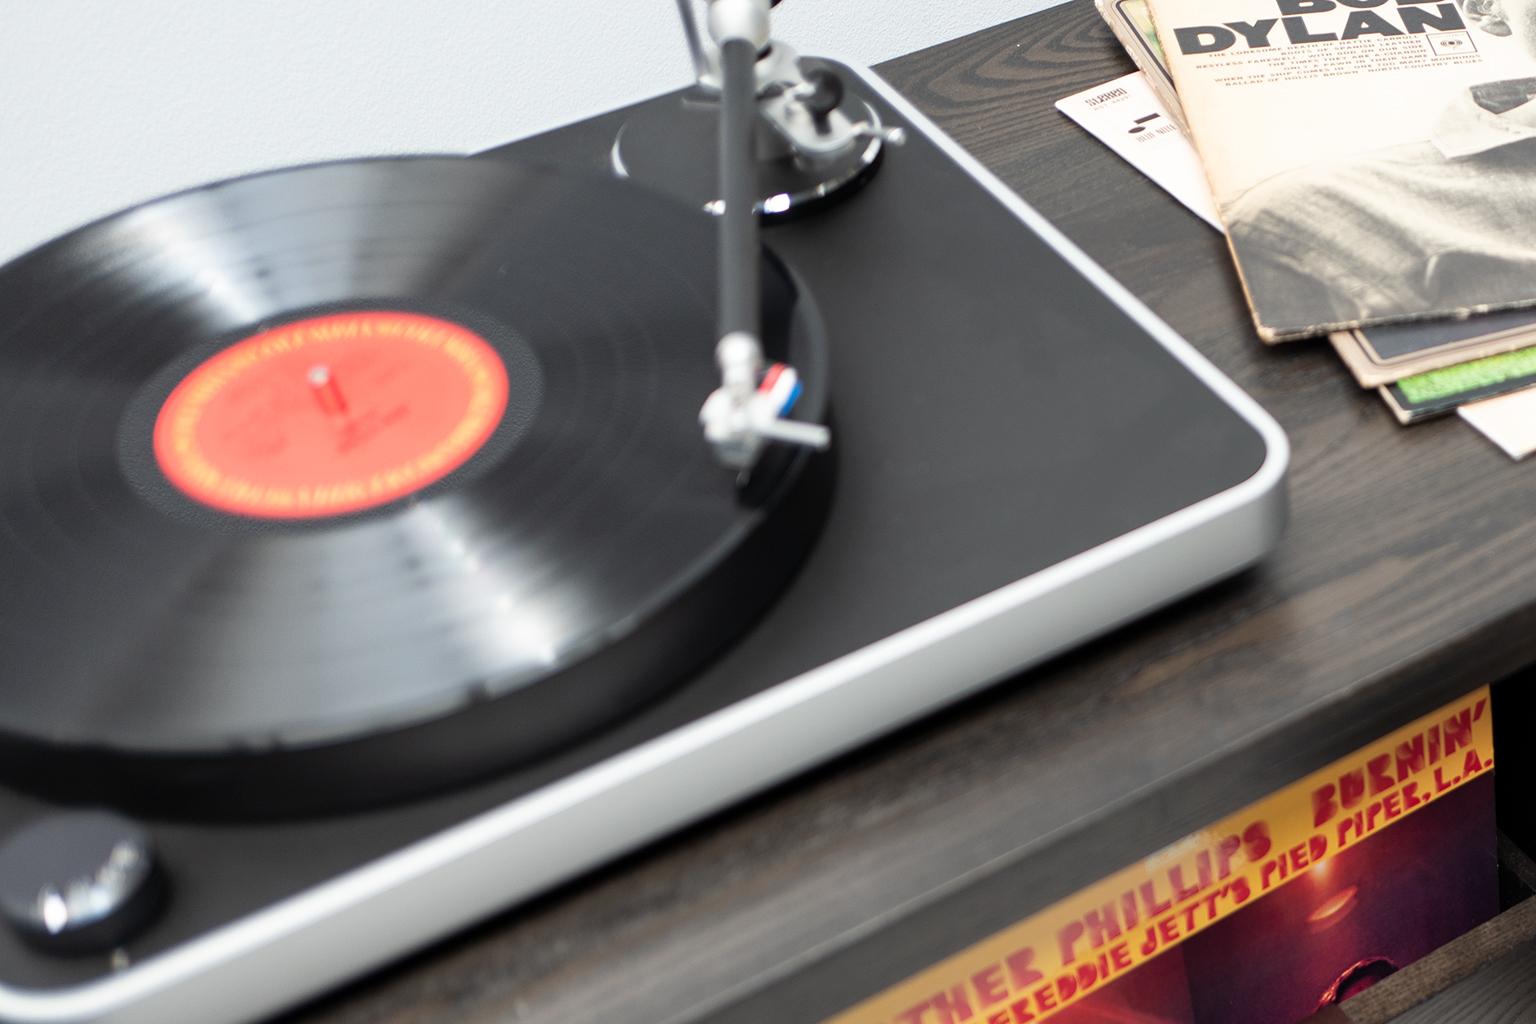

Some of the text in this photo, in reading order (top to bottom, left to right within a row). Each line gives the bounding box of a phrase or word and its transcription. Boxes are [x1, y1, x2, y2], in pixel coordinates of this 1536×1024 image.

[1173, 2, 1467, 55] DYLAN
[1057, 818, 1272, 967] PHILLIPS
[1311, 697, 1488, 828] BURNIN'
[1140, 876, 1251, 957] JETT'S
[1259, 834, 1328, 890] PIED
[1337, 781, 1432, 848] PIPER,
[1434, 749, 1493, 794] L.A.
